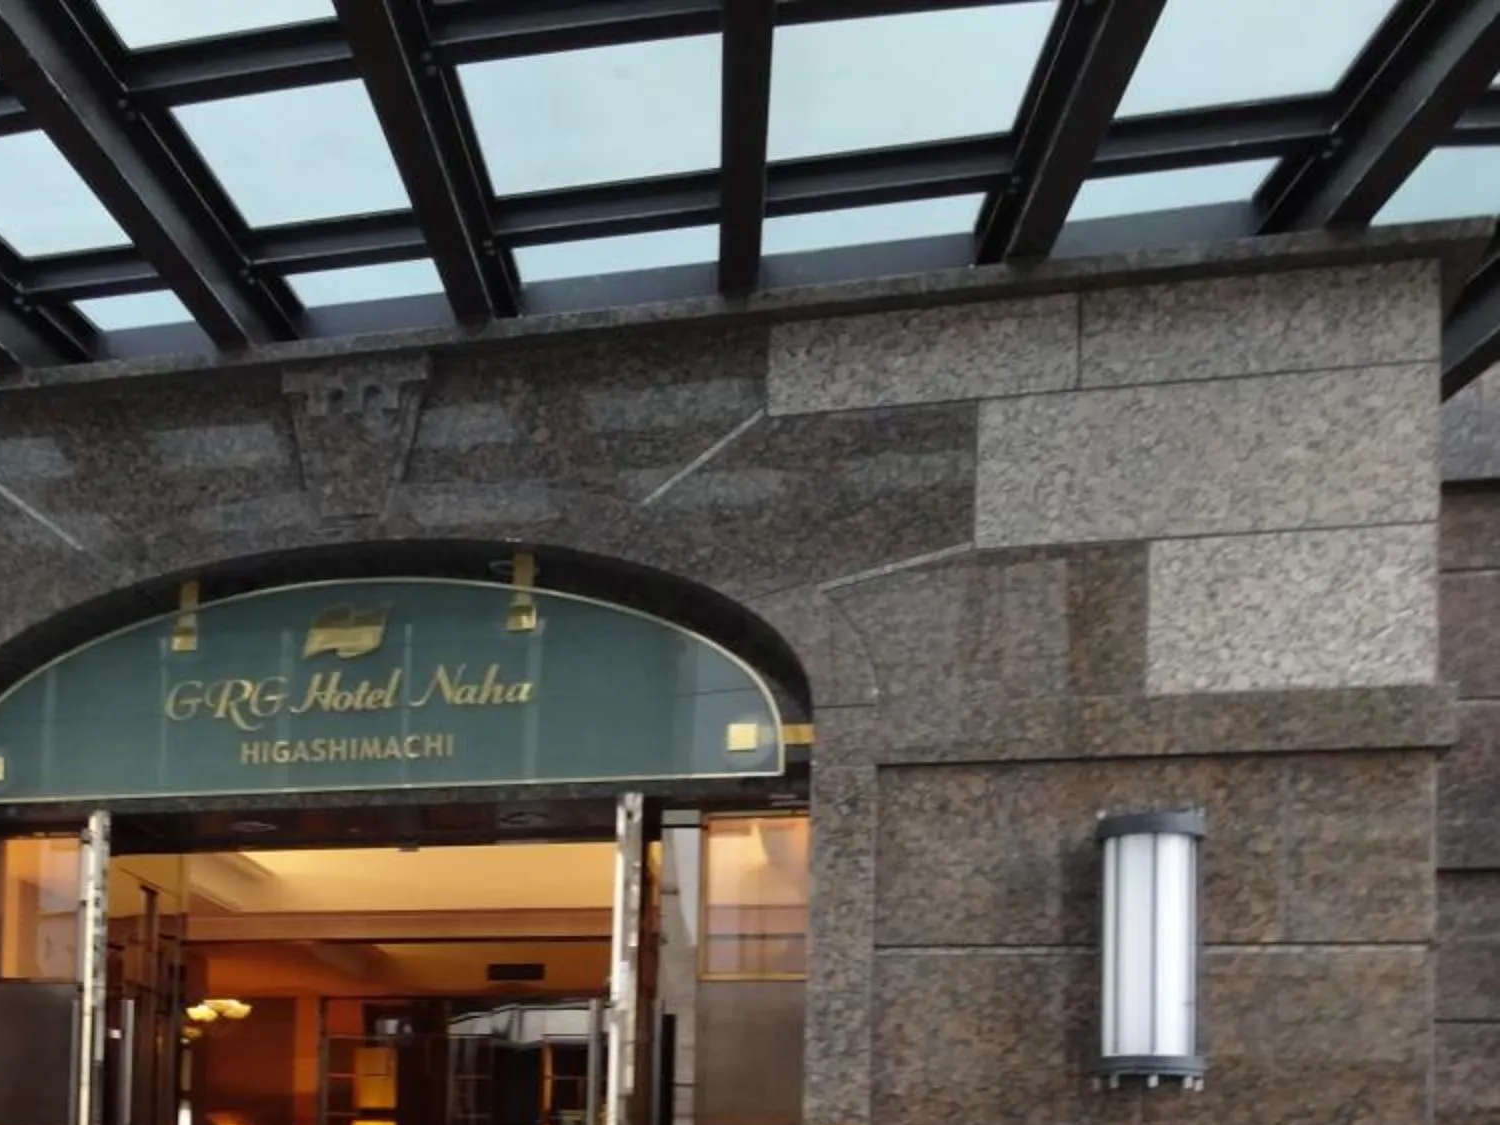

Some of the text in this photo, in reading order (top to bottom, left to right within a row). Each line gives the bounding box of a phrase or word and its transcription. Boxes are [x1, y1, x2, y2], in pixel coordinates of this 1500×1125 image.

[164, 662, 534, 732] GRG Hotel Naha
[240, 733, 456, 765] HIGASHIMACHI
